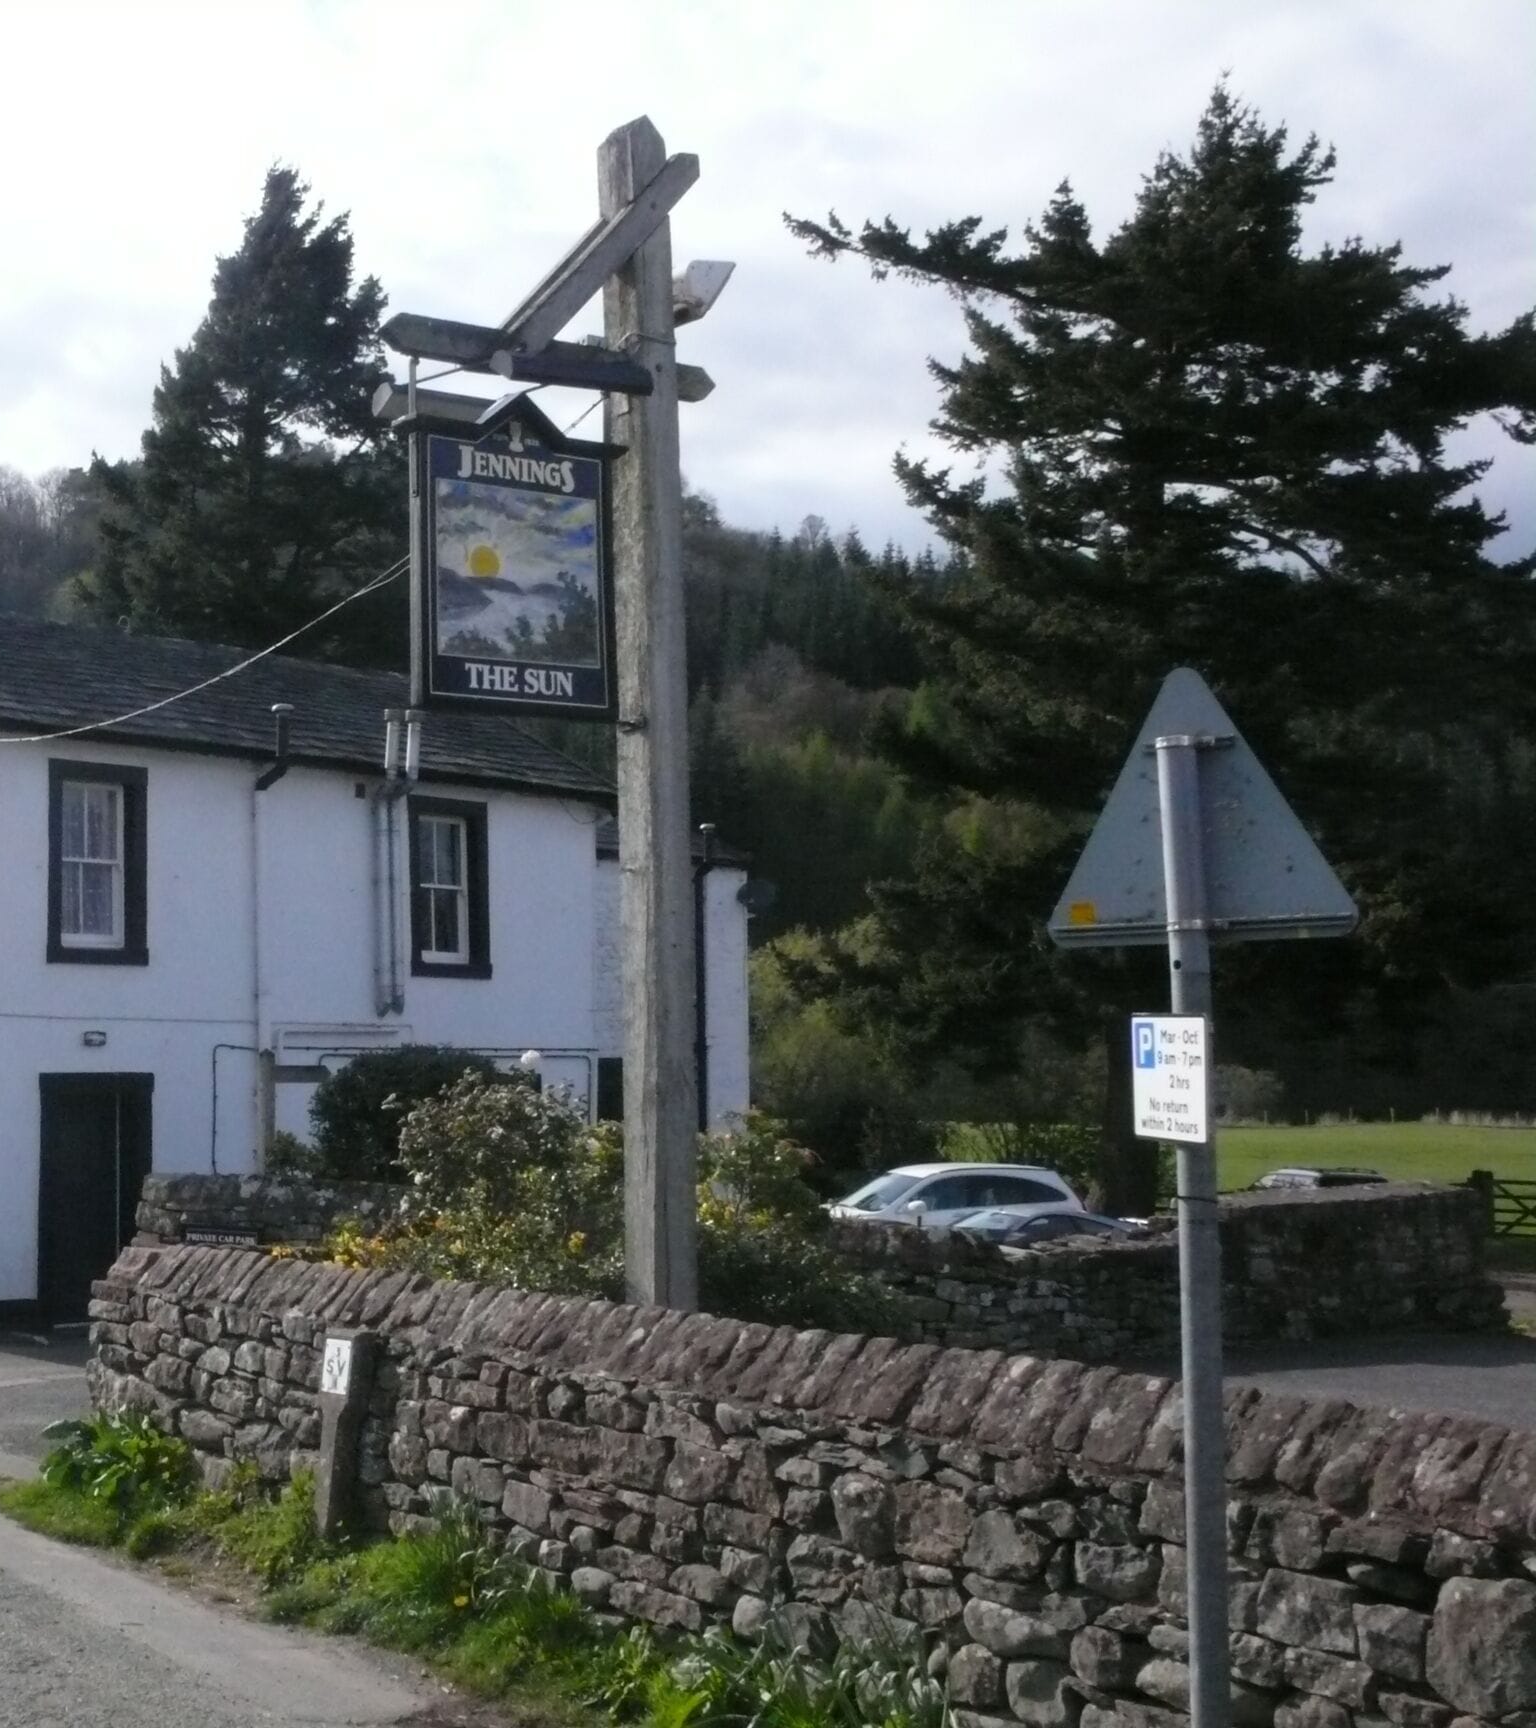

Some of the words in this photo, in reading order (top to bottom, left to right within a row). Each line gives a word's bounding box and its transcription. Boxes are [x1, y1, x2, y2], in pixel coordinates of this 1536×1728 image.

[457, 444, 575, 493] JENNINGS
[464, 662, 519, 692] THE
[524, 669, 574, 697] SUN
[1160, 1030, 1176, 1044] Mar
[1182, 1029, 1199, 1045] Oct
[1139, 1027, 1153, 1065] P
[1182, 1051, 1188, 1066] 7
[1189, 1055, 1203, 1068] pm
[1169, 1074, 1175, 1089] 2
[1176, 1075, 1190, 1090] hrs
[1149, 1097, 1161, 1112] No
[1163, 1101, 1189, 1114] return
[1141, 1115, 1164, 1131] within
[1167, 1117, 1173, 1132] 2
[1174, 1118, 1199, 1135] hours
[186, 1232, 217, 1242] PRIVATE
[218, 1235, 234, 1243] CAR
[235, 1236, 255, 1246] PARK
